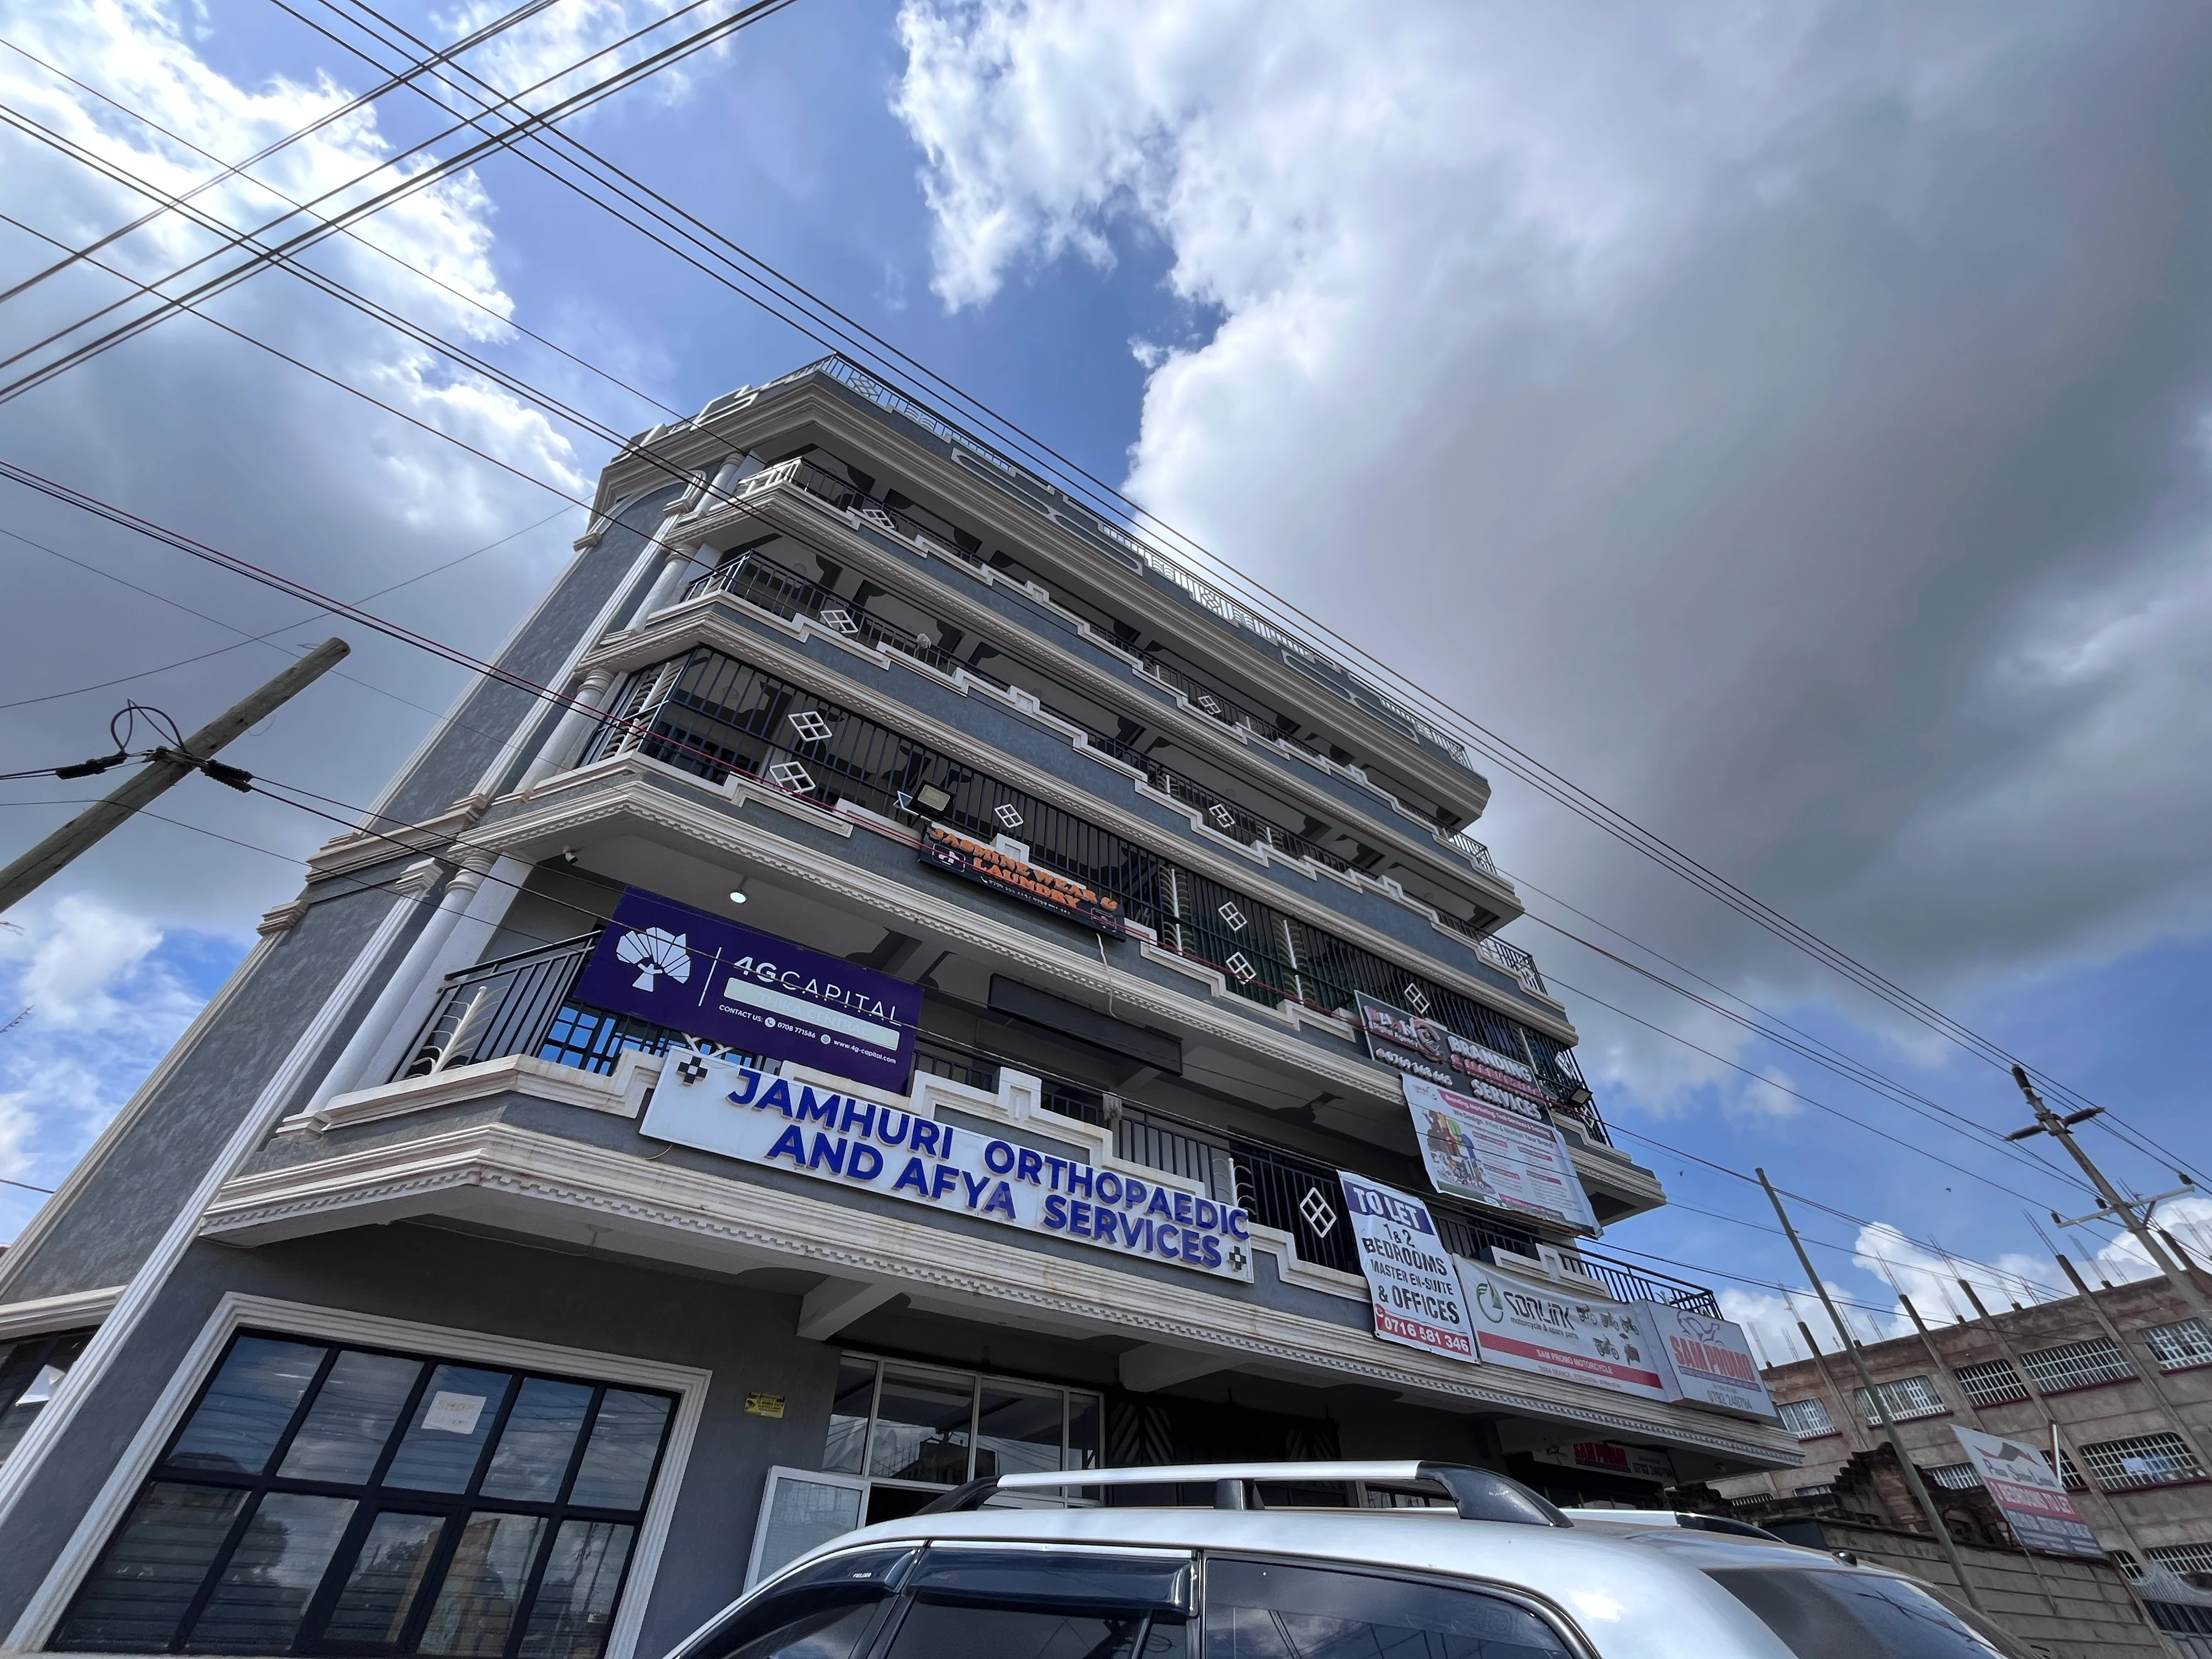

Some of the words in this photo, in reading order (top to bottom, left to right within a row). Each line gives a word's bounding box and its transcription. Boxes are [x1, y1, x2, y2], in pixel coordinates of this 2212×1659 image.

[930, 828, 1030, 877] JASMINE
[1033, 869, 1098, 904] WEAR
[972, 857, 1080, 908] LAUNDRY
[719, 1005, 752, 1020] CONTACT
[752, 1014, 763, 1023] US:
[777, 1022, 793, 1032] 0708
[794, 1025, 816, 1039] 771586
[833, 1040, 896, 1064] www.4g-capital.com
[758, 991, 804, 1015] THIKA
[806, 1008, 867, 1036] CENTRAL
[1448, 1036, 1532, 1082] BRANDING
[1471, 1079, 1542, 1120] SERVICES
[726, 1068, 953, 1160] JAMHURI
[984, 1140, 1250, 1241] ORTHOPAEDIC
[765, 1124, 884, 1181] AND
[892, 1158, 1017, 1220] AFYA
[1042, 1194, 1222, 1268] SERVICES
[1353, 1186, 1384, 1215] TO
[1384, 1196, 1420, 1229] LET
[1361, 1237, 1447, 1276] BEDROOMS
[1370, 1259, 1408, 1284] MASTER
[1409, 1273, 1454, 1295] EN-SUITE
[1378, 1285, 1389, 1304] &
[1391, 1285, 1460, 1324] OFFICES
[1384, 1317, 1417, 1337] 0716
[1419, 1327, 1441, 1345] 581
[1444, 1335, 1469, 1352] 346
[1543, 1323, 1548, 1331] &
[1536, 1348, 1551, 1360] SAM
[1551, 1352, 1573, 1365] PROMO
[1573, 1357, 1613, 1374] MOTORCYCLE
[1669, 1335, 1709, 1372] SAM
[1703, 1343, 1756, 1382] PROMO
